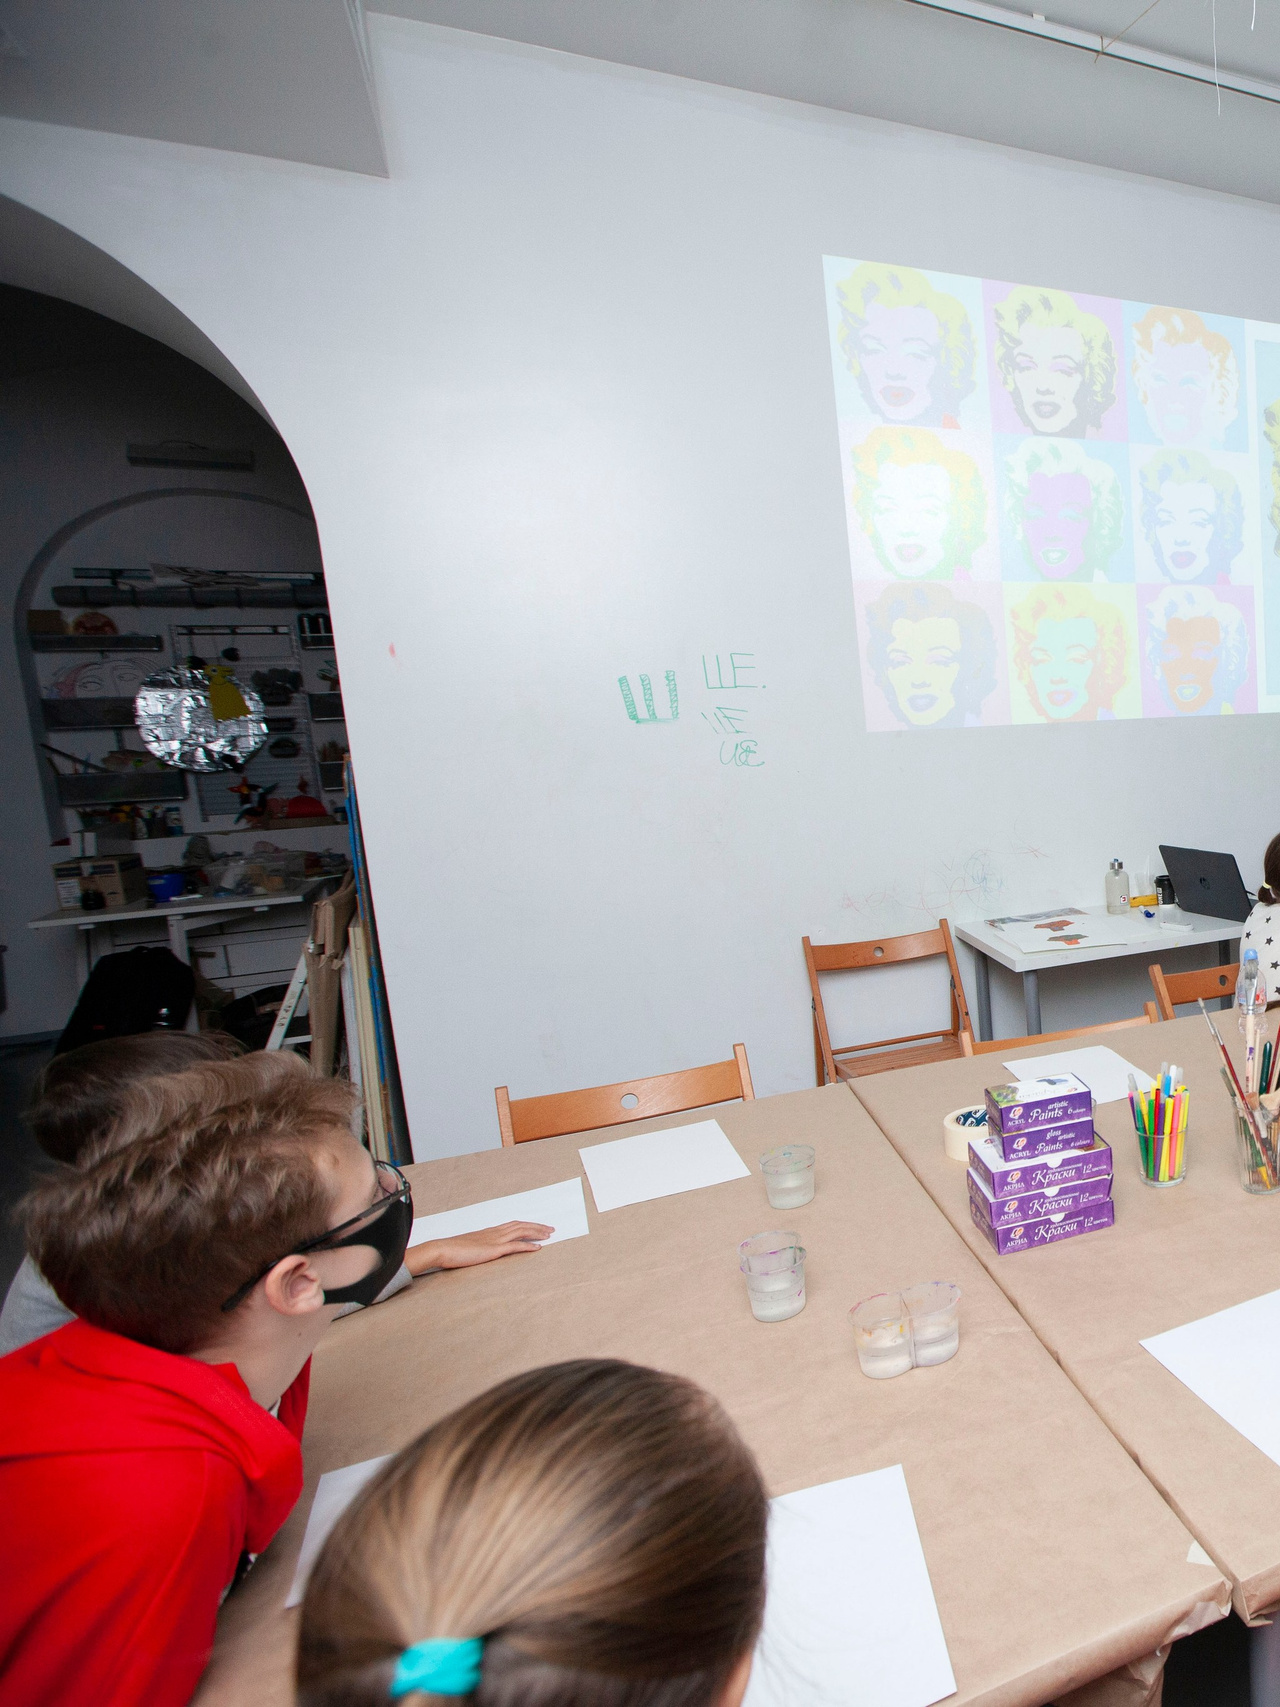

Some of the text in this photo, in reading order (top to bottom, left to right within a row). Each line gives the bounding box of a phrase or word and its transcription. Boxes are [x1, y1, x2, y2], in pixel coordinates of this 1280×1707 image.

[1047, 1100, 1068, 1110] artistic
[1028, 1108, 1063, 1123] Paints
[1067, 1107, 1073, 1115] 6
[1008, 1119, 1026, 1127] ACRYL
[1035, 1142, 1063, 1155] Paints
[1009, 1150, 1031, 1160] ACRYL
[1031, 1168, 1076, 1188] Краски
[1082, 1163, 1092, 1174] 12
[1003, 1182, 1025, 1192] АКРИЛ
[1028, 1197, 1073, 1217] Краски
[1079, 1192, 1089, 1202] 12
[1000, 1211, 1022, 1221] АКРИЛ
[1034, 1222, 1078, 1242] Краски
[1084, 1216, 1093, 1227] 12
[1006, 1237, 1028, 1248] АКРИЛ
